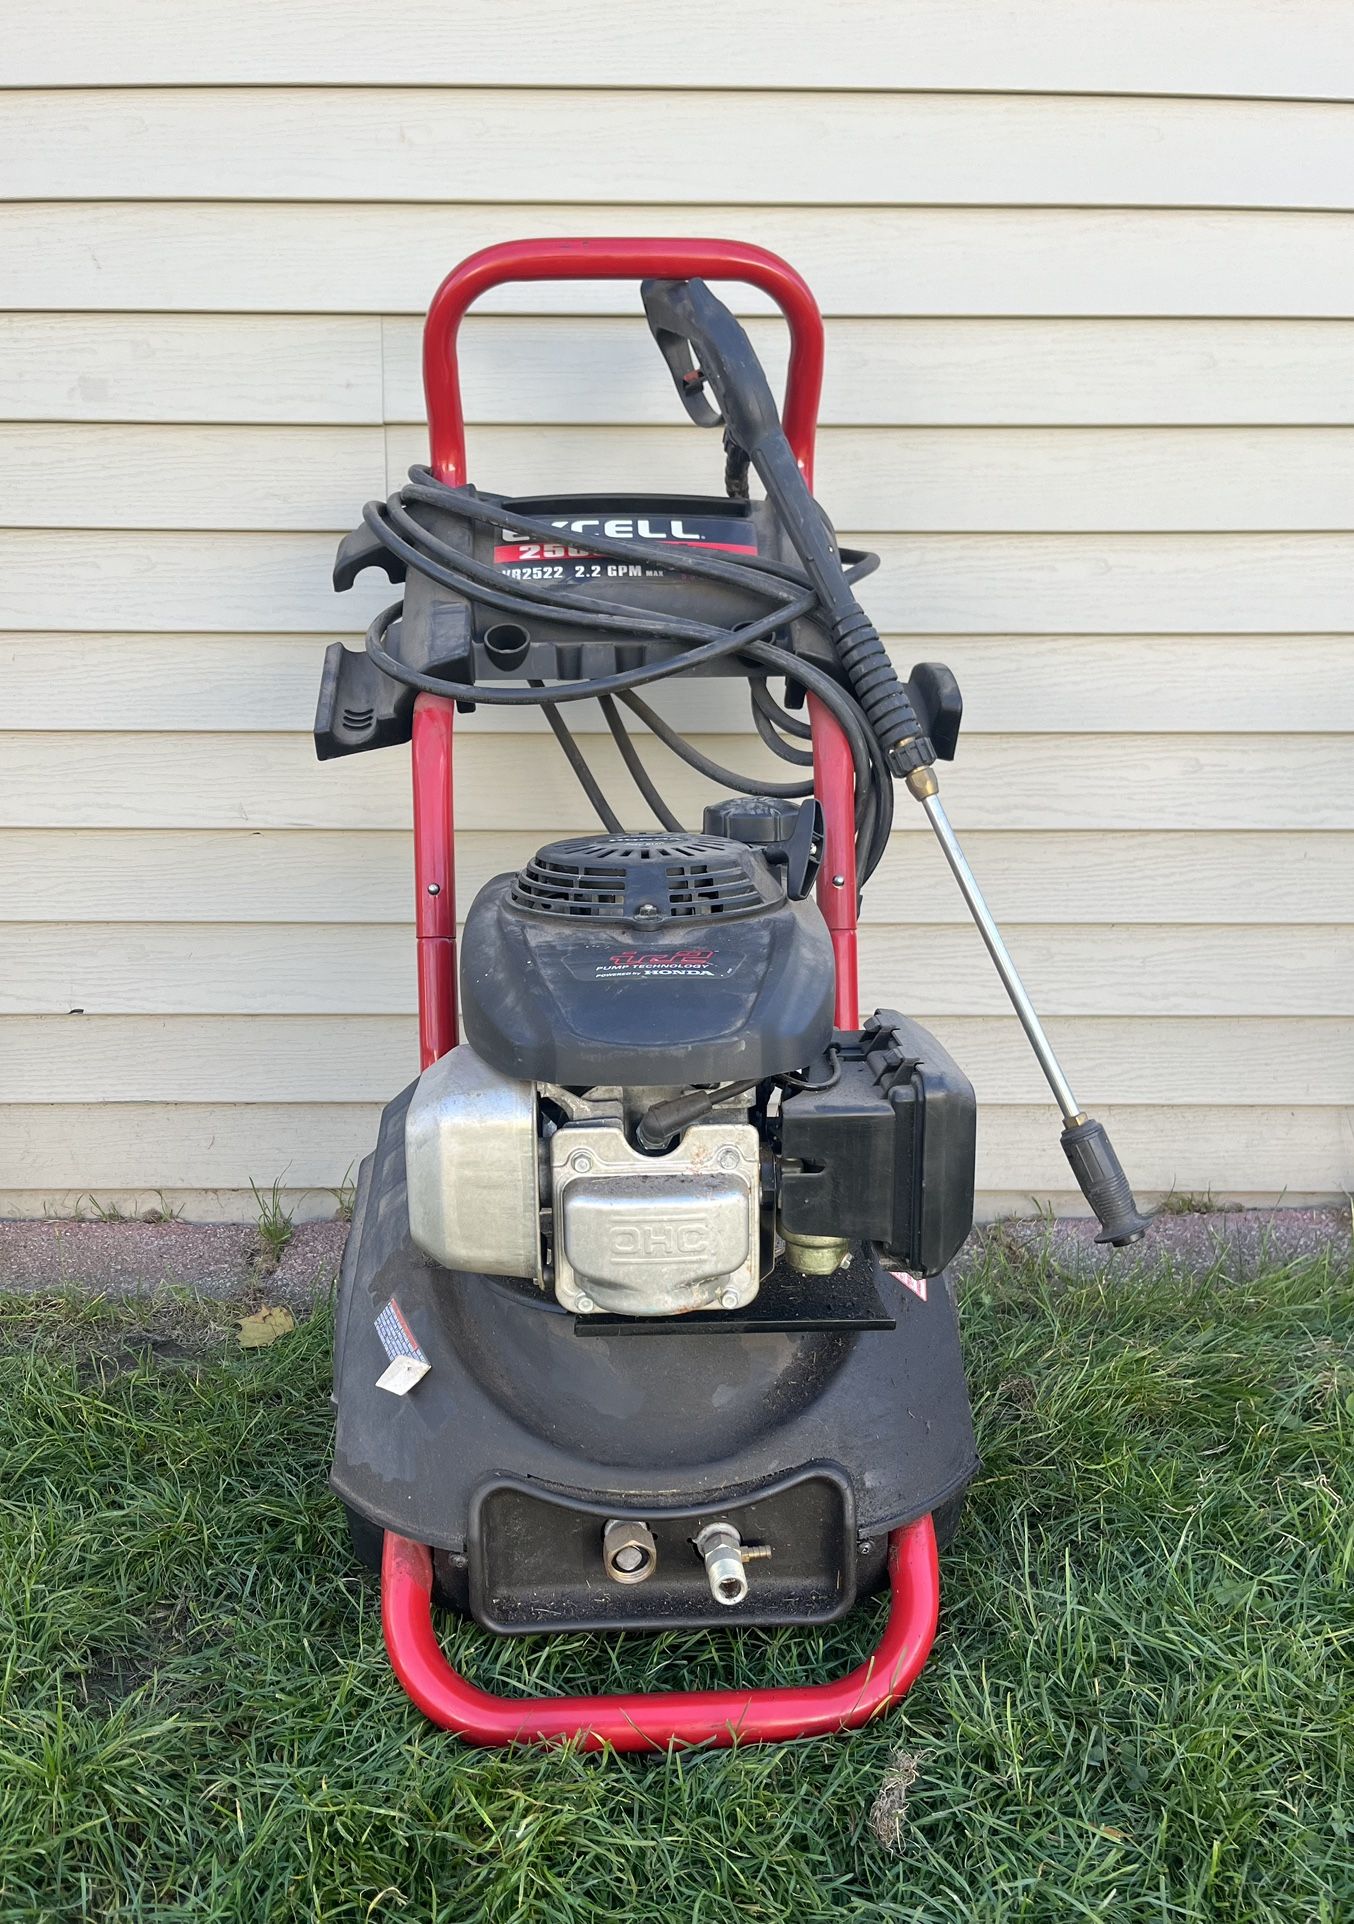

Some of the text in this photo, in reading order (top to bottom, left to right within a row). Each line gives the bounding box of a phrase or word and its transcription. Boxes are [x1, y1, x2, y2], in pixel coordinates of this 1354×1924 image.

[575, 565, 601, 578] 2.2
[607, 565, 642, 577] GPM
[609, 1225, 709, 1254] OHC
